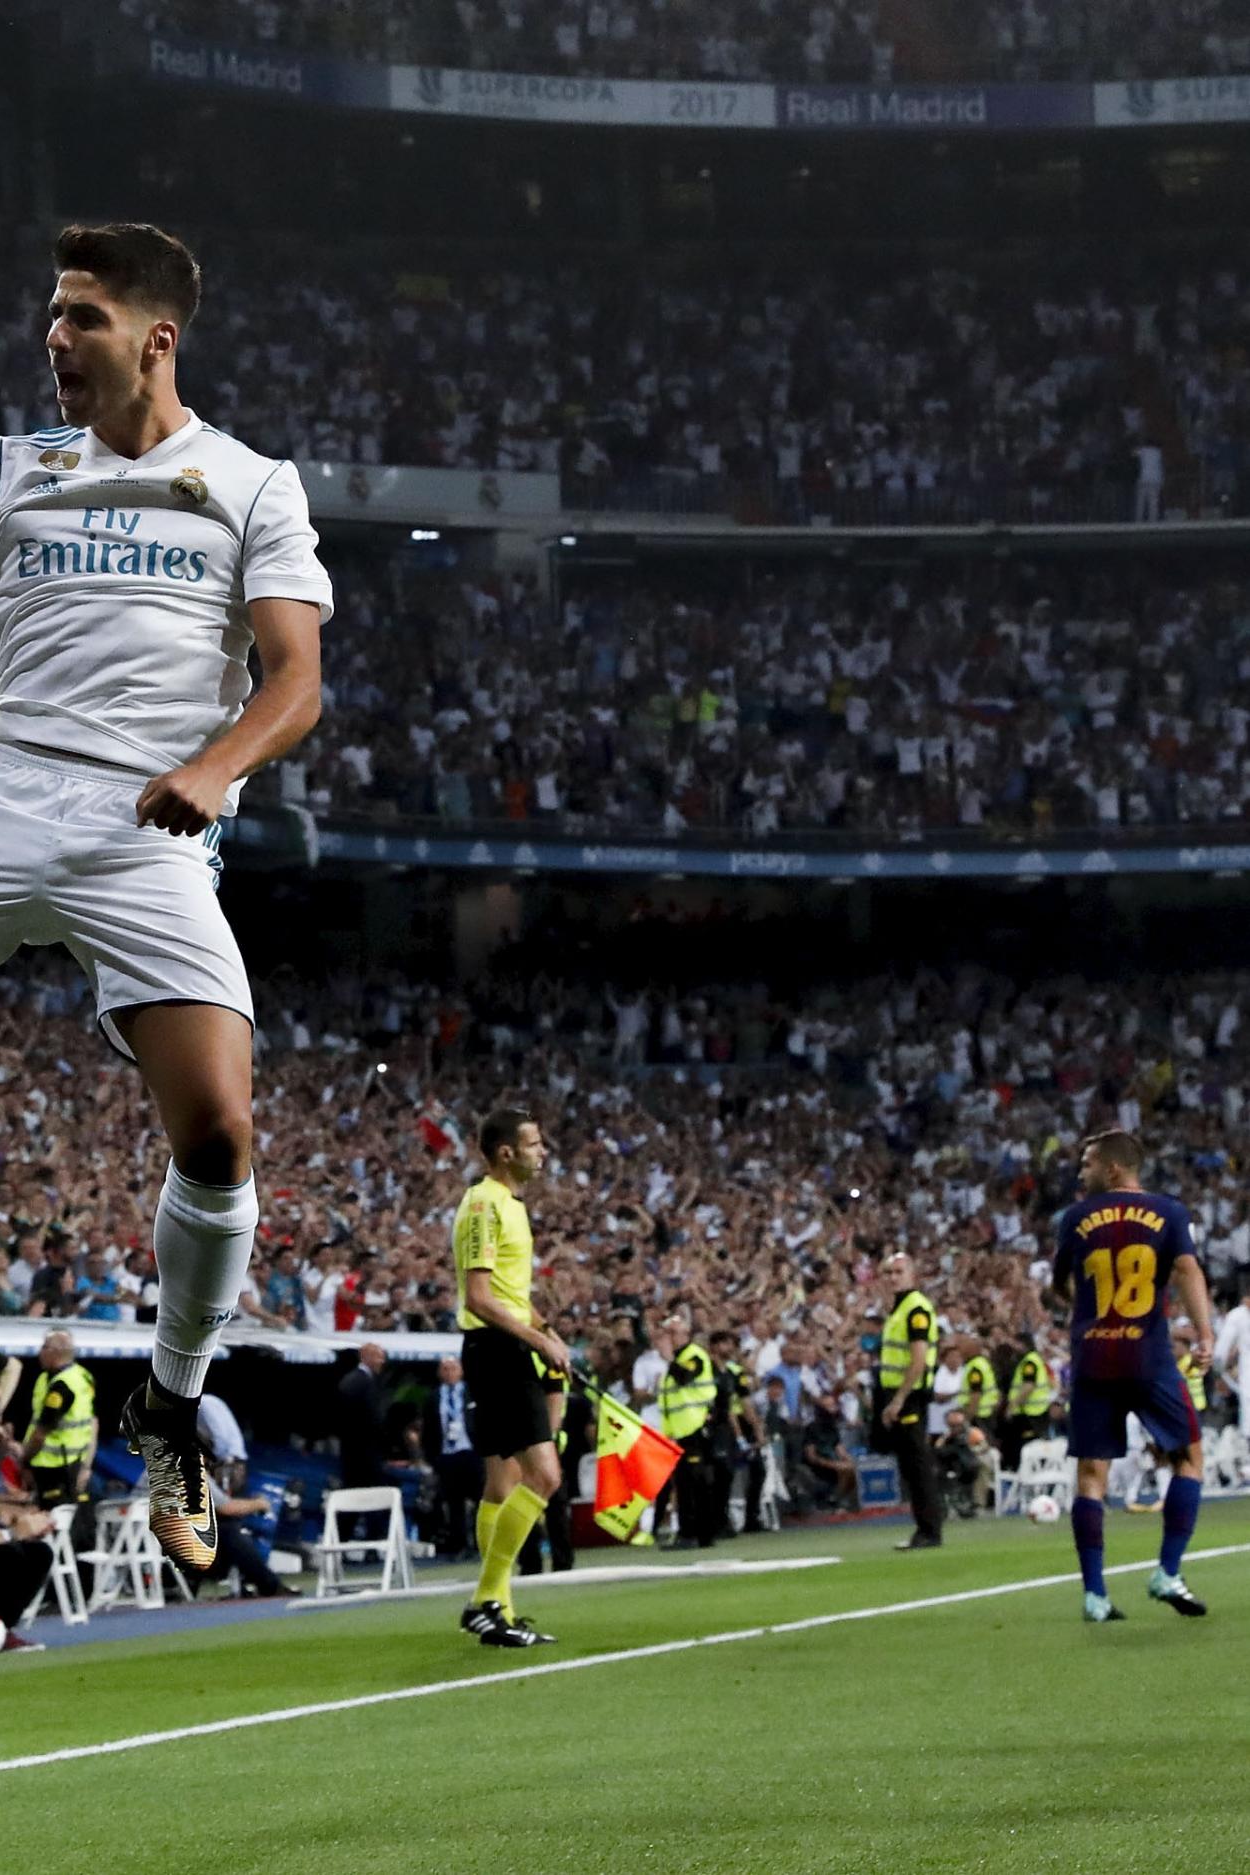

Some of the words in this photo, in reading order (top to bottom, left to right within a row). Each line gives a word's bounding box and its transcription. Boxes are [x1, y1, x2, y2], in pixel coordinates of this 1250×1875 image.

[150, 39, 207, 79] Real
[214, 50, 302, 93] Madrid
[459, 73, 616, 103] SUPERCOPA
[670, 88, 738, 118] 2017
[786, 90, 858, 123] Real
[869, 92, 988, 124] Madrid
[82, 507, 141, 535] Fly
[17, 532, 208, 583] Emirates
[1075, 1207, 1121, 1240] JORDI
[1123, 1207, 1166, 1233] ALBA
[1083, 1243, 1157, 1320] 18
